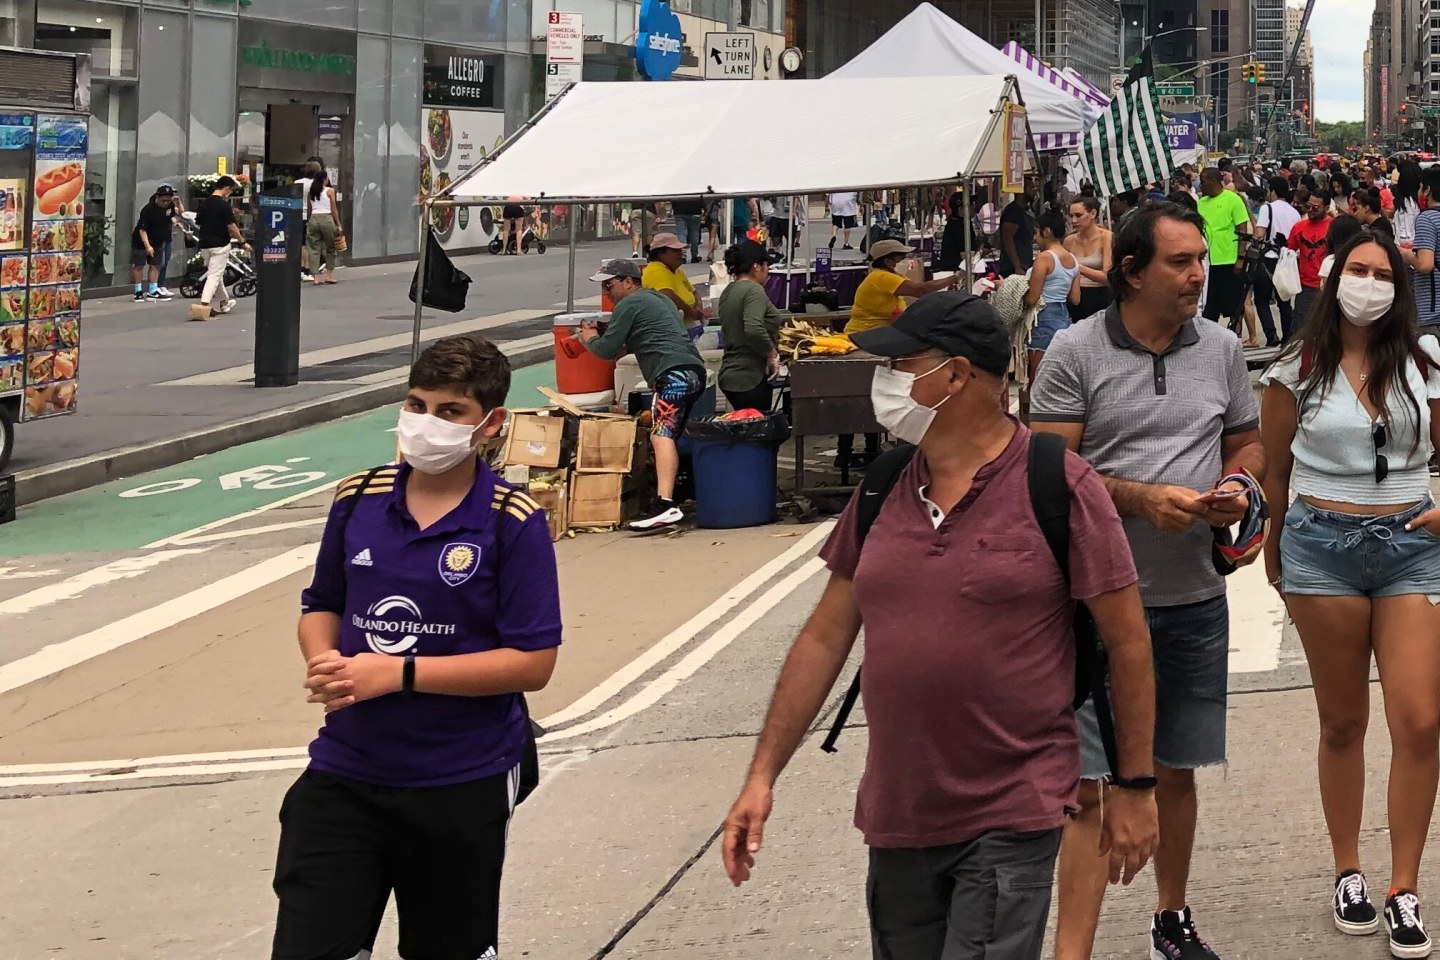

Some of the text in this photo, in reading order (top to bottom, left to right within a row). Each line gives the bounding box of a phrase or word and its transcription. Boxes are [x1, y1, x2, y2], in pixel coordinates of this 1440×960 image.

[551, 13, 558, 24] 3
[726, 39, 750, 48] LEFT
[726, 52, 750, 61] TURN
[448, 56, 484, 83] ALLEGRO
[549, 65, 556, 75] 5
[724, 65, 750, 74] LANE
[450, 85, 480, 98] COFFEE
[272, 211, 283, 228] P
[352, 614, 456, 634] ORLANDO HEALTH
